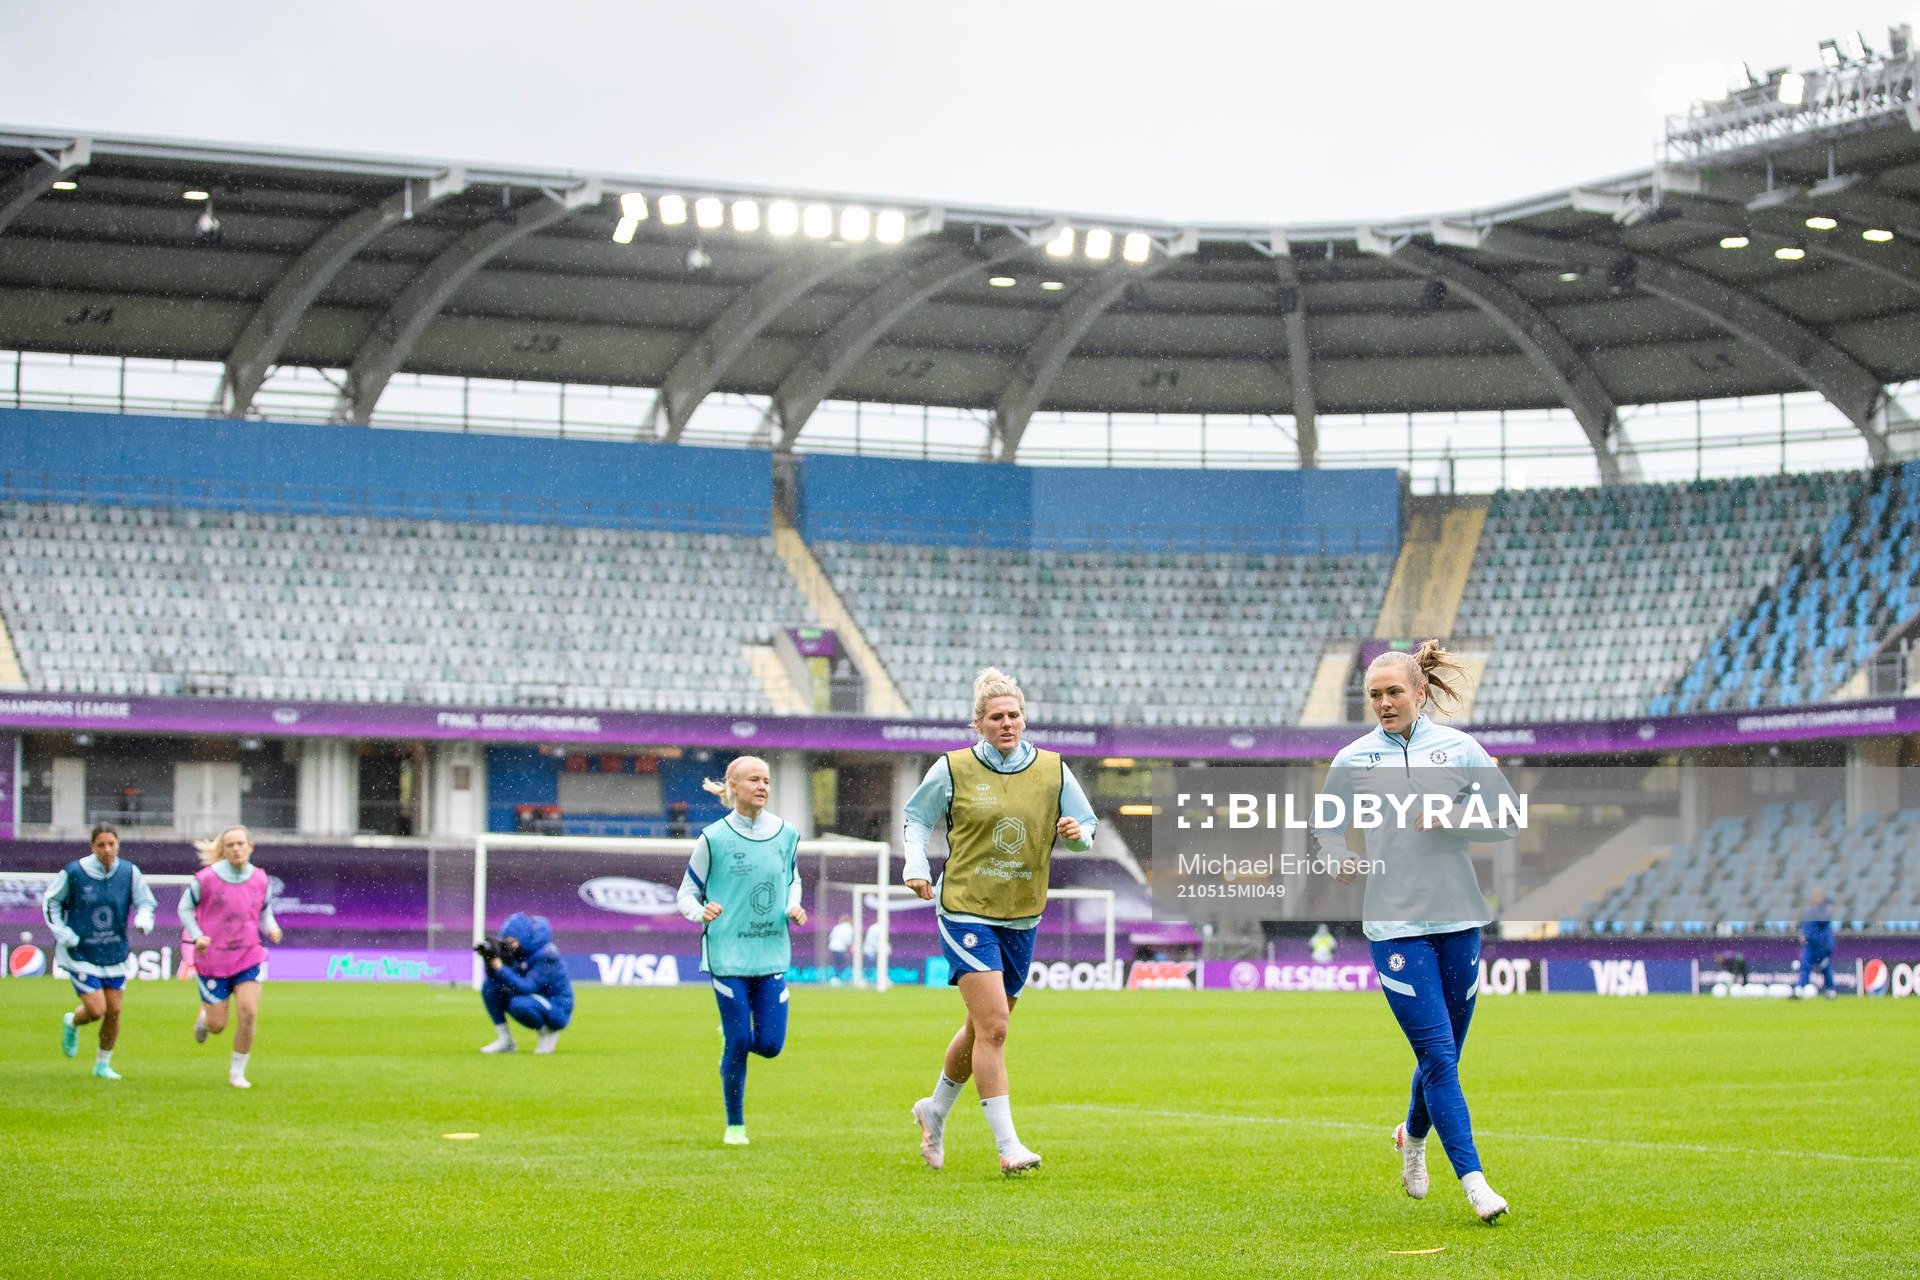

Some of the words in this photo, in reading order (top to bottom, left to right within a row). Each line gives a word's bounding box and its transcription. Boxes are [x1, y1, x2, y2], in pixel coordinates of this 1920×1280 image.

[0, 698, 74, 718] HAMPIONS
[75, 701, 130, 720] LEAGUE
[436, 712, 477, 729] FINAL
[1369, 752, 1381, 764] 16
[975, 866, 1032, 880] #WePlayStrong
[991, 857, 1024, 868] Together
[590, 953, 680, 986] VISA
[1264, 965, 1372, 991] RESPECT
[1479, 958, 1531, 994] LOT
[1590, 960, 1649, 995] VISA
